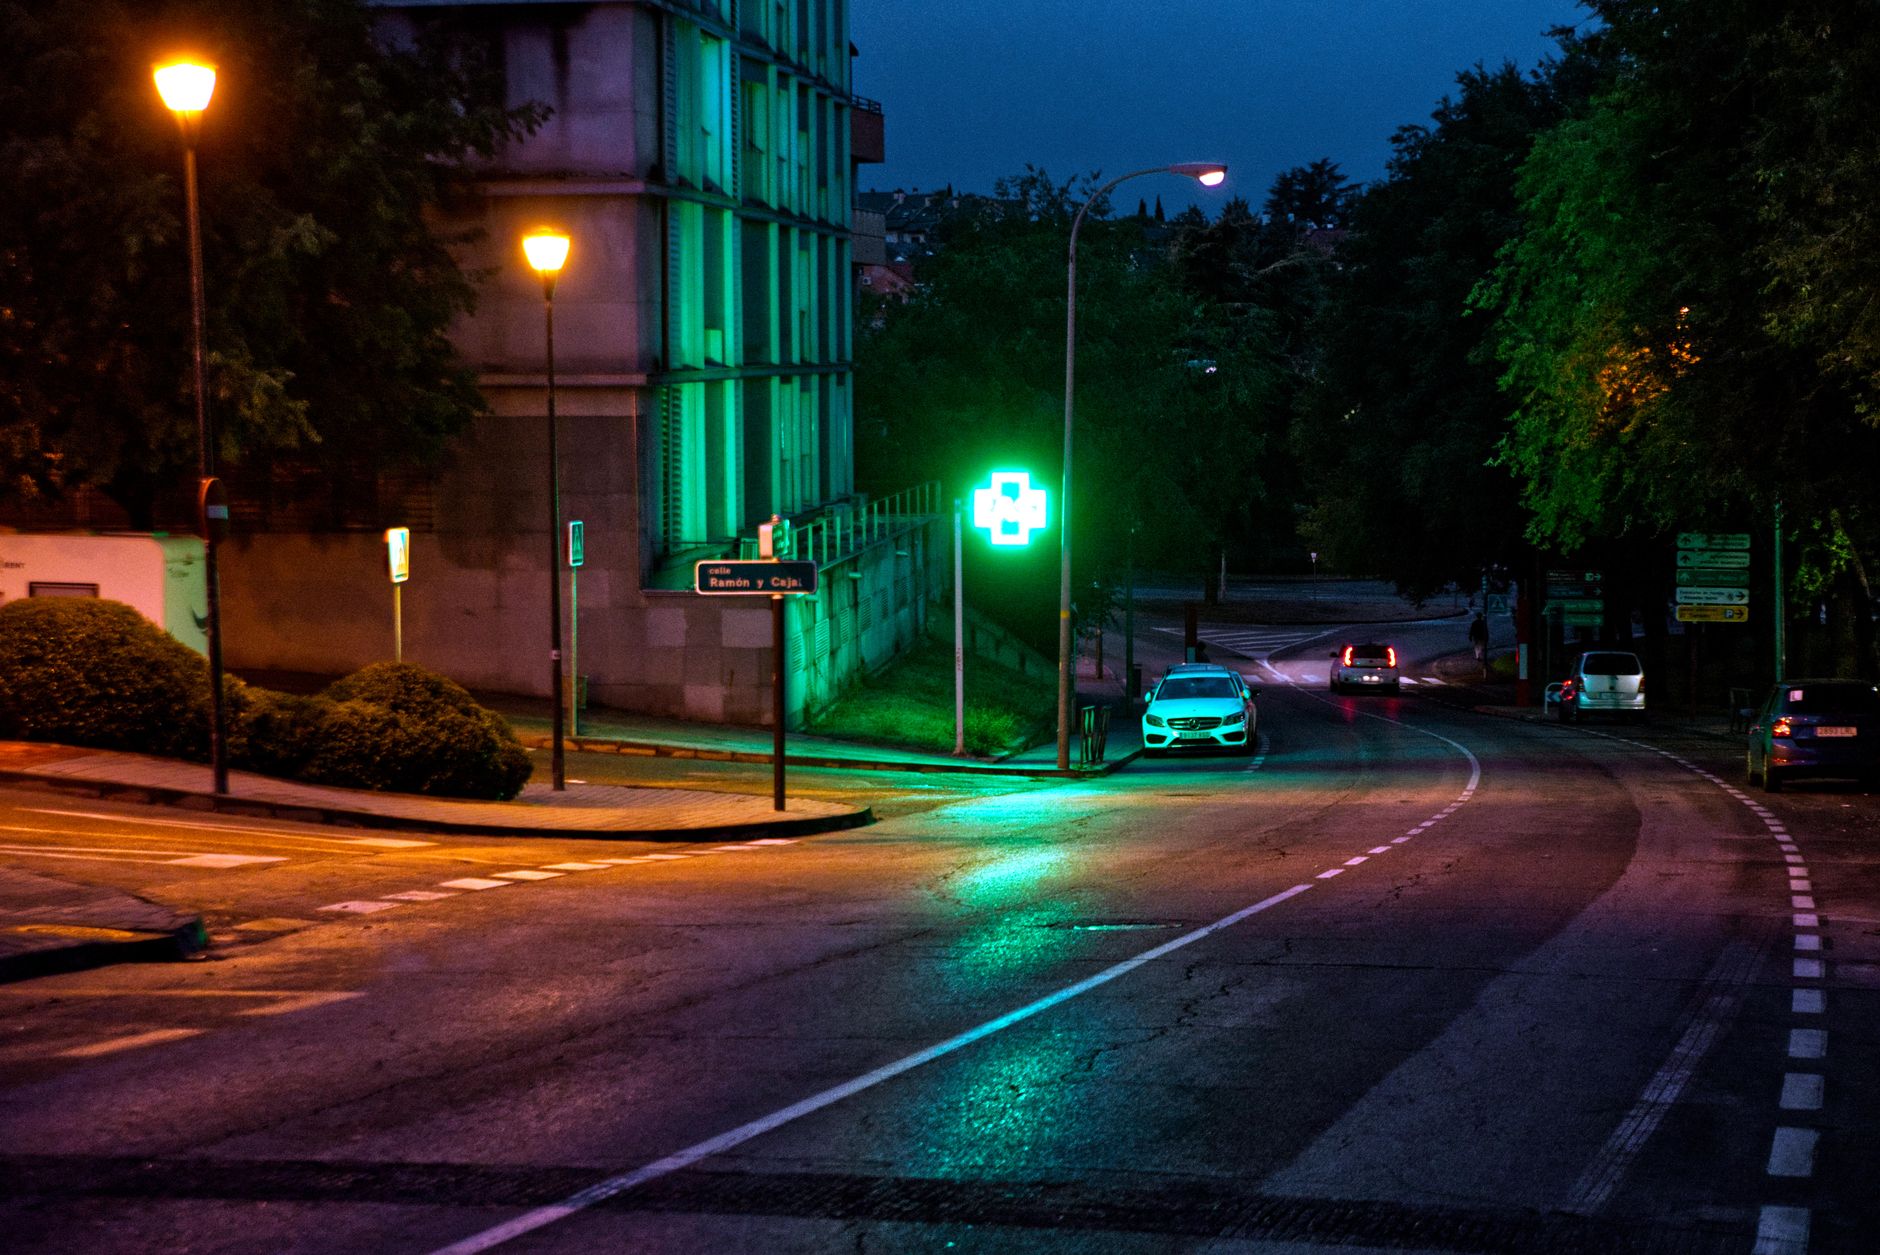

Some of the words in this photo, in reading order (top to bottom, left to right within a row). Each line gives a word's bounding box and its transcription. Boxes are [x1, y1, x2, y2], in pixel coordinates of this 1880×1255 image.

[709, 567, 731, 575] calle
[710, 577, 750, 587] Ramón
[757, 579, 764, 589] y
